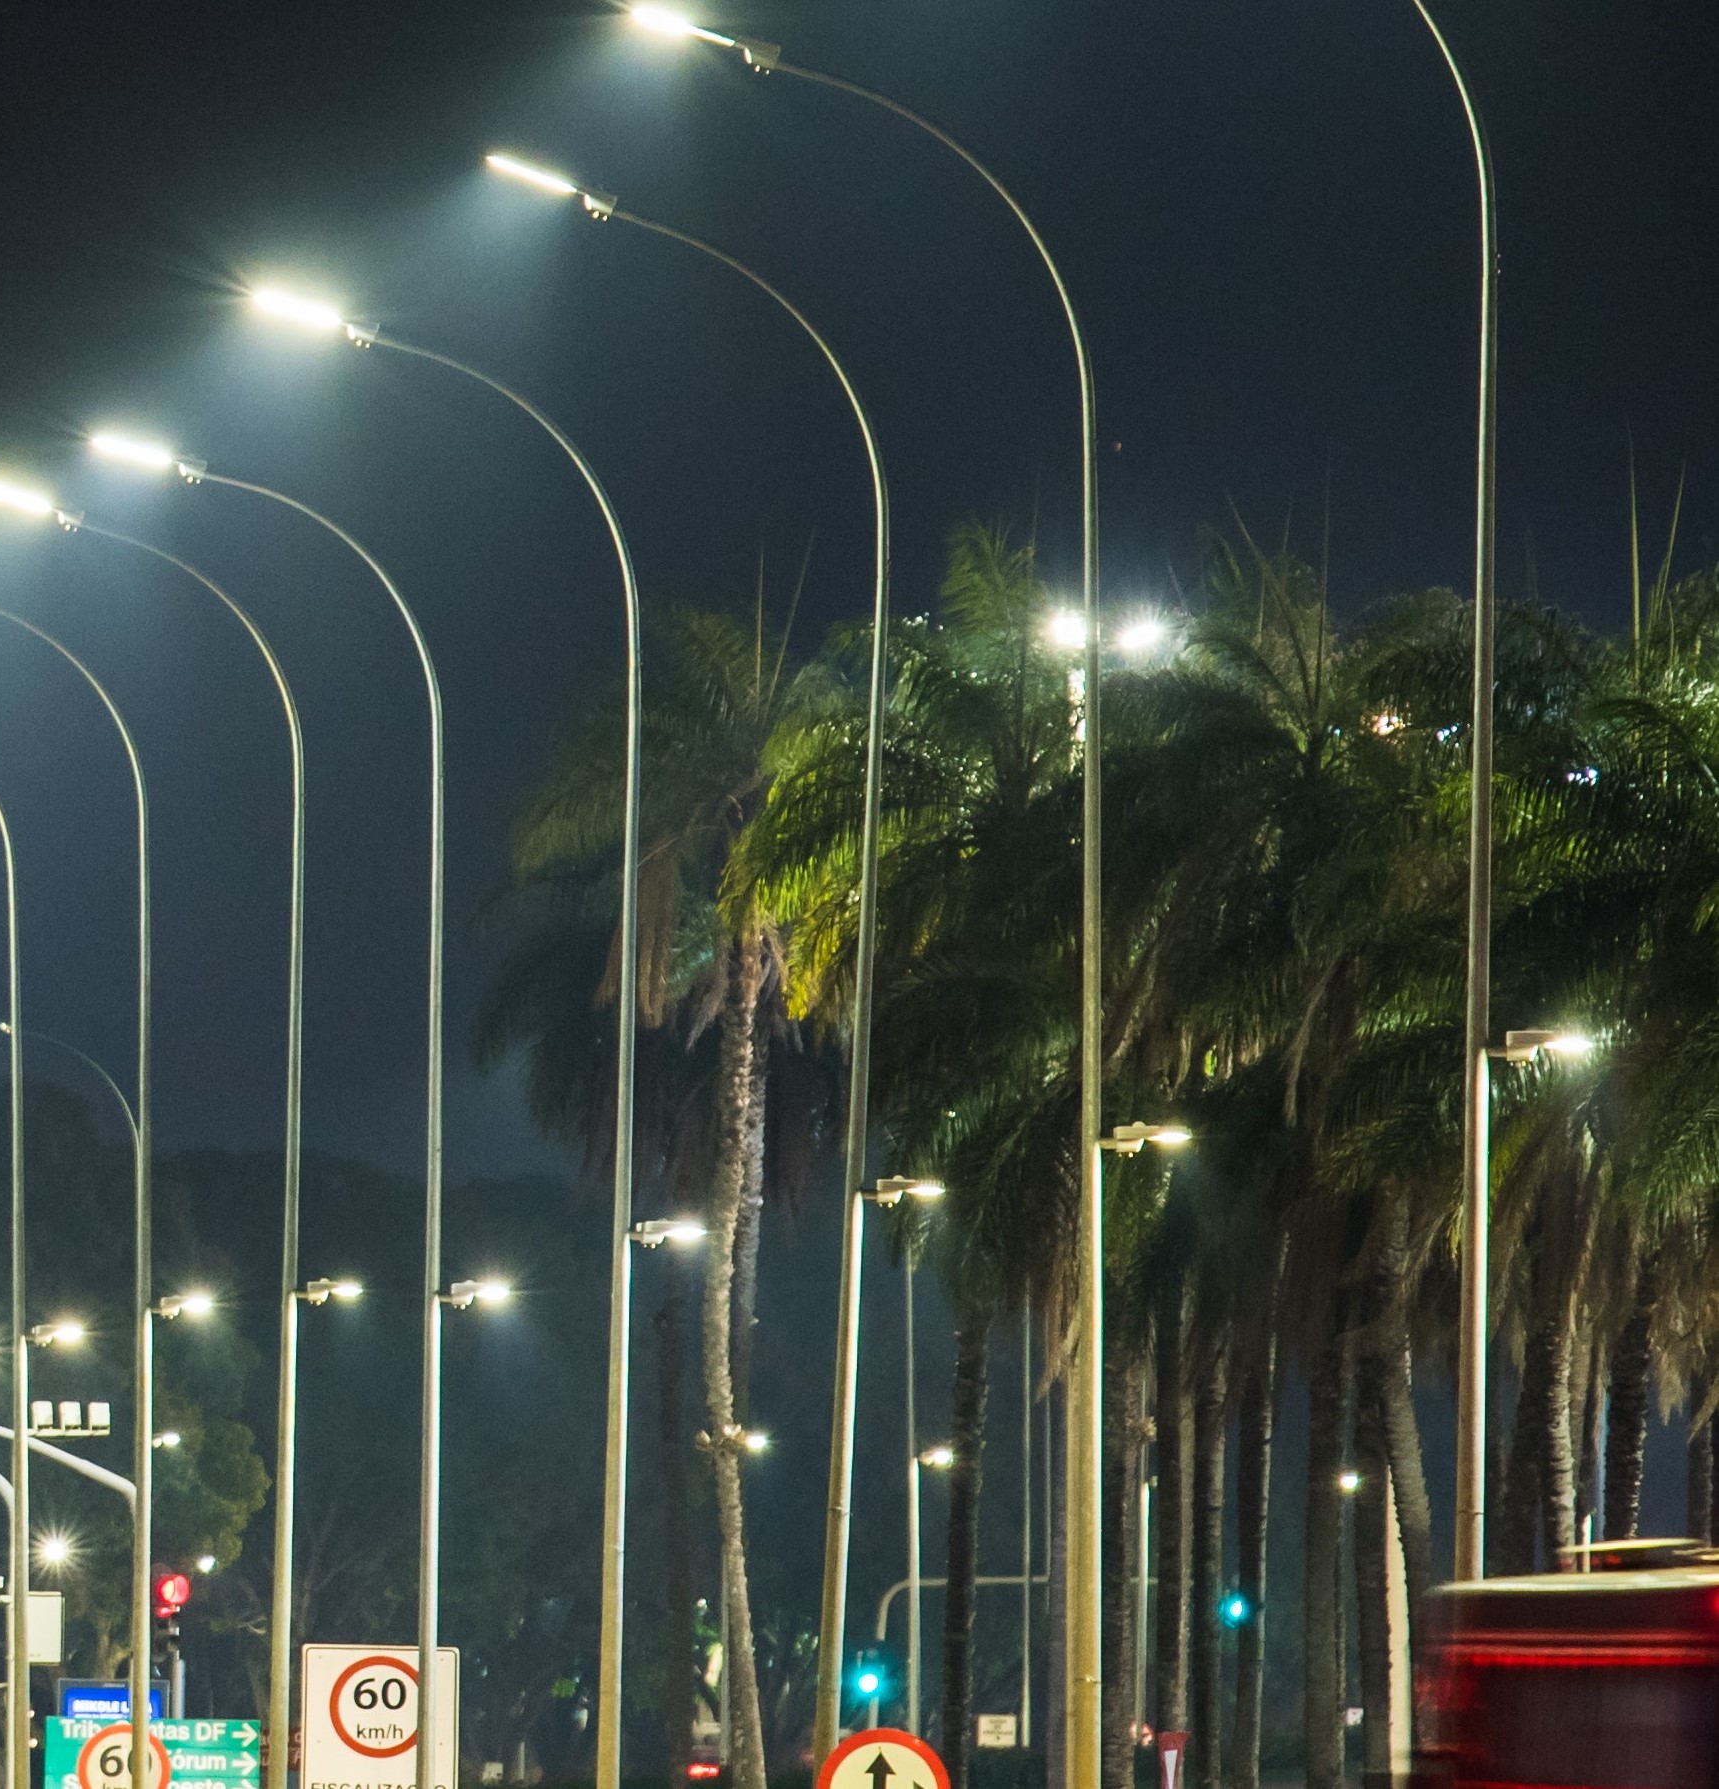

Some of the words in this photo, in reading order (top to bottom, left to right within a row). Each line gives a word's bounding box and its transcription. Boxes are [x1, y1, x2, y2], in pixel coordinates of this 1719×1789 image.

[354, 1678, 407, 1710] 60
[195, 1722, 226, 1742] DF
[356, 1724, 404, 1740] km/h
[167, 1748, 226, 1771] órum
